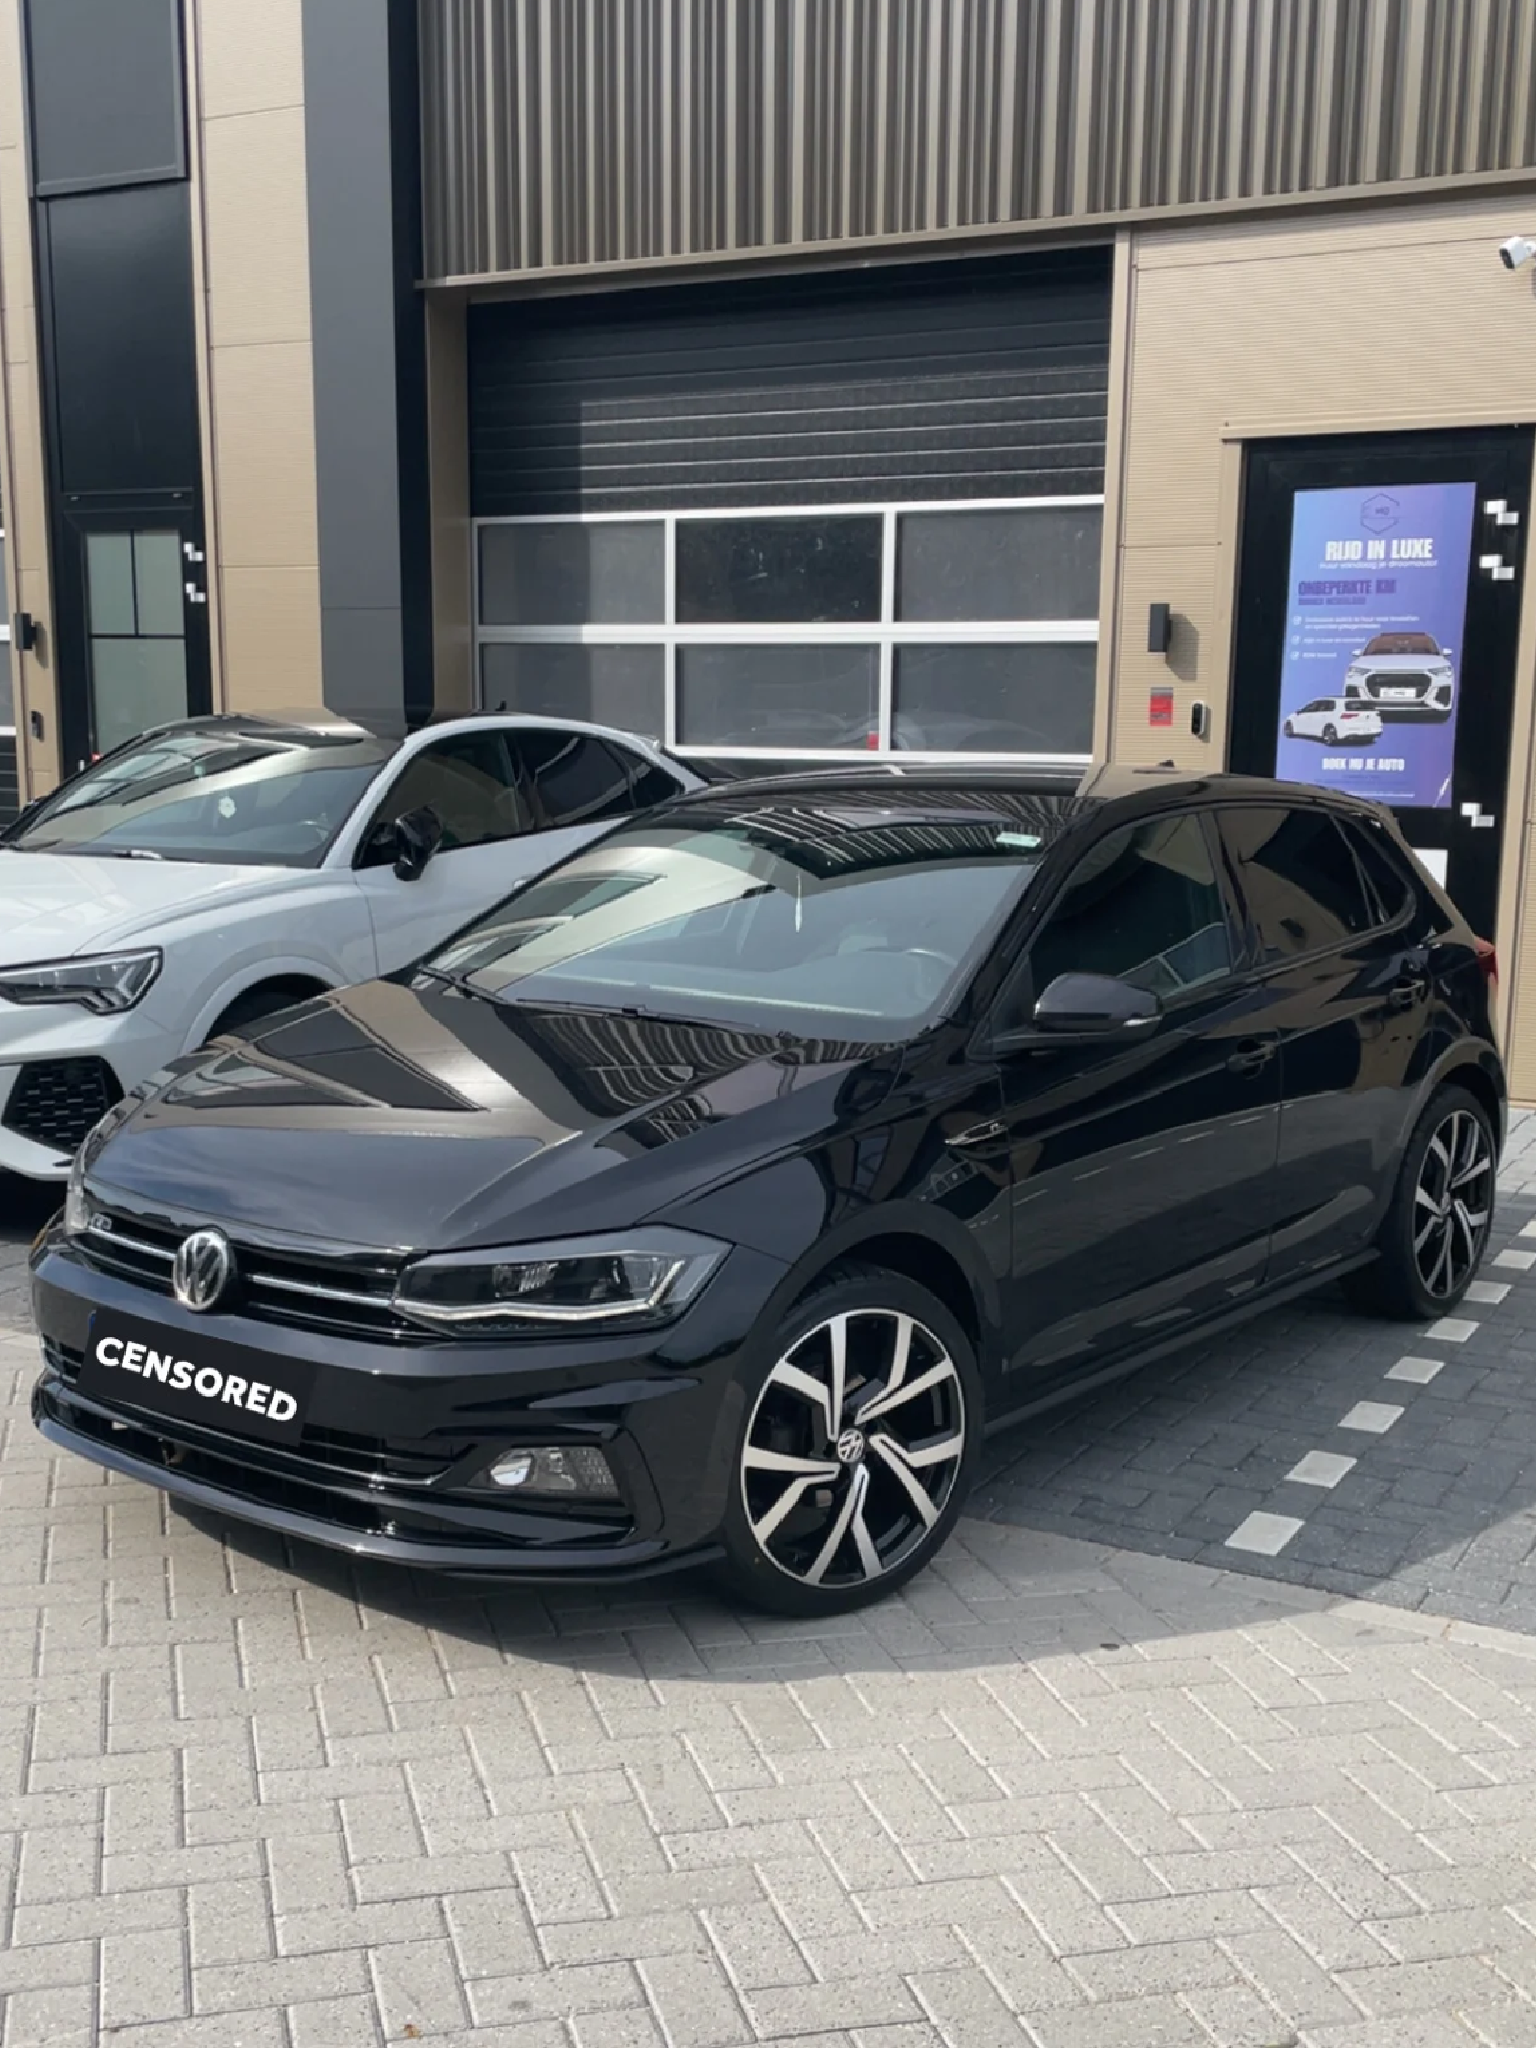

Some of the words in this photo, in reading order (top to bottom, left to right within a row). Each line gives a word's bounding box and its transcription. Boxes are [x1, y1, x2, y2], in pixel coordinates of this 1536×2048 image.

[1367, 539, 1386, 560] IN
[1391, 538, 1433, 559] LUXE
[1377, 758, 1405, 771] AUTO
